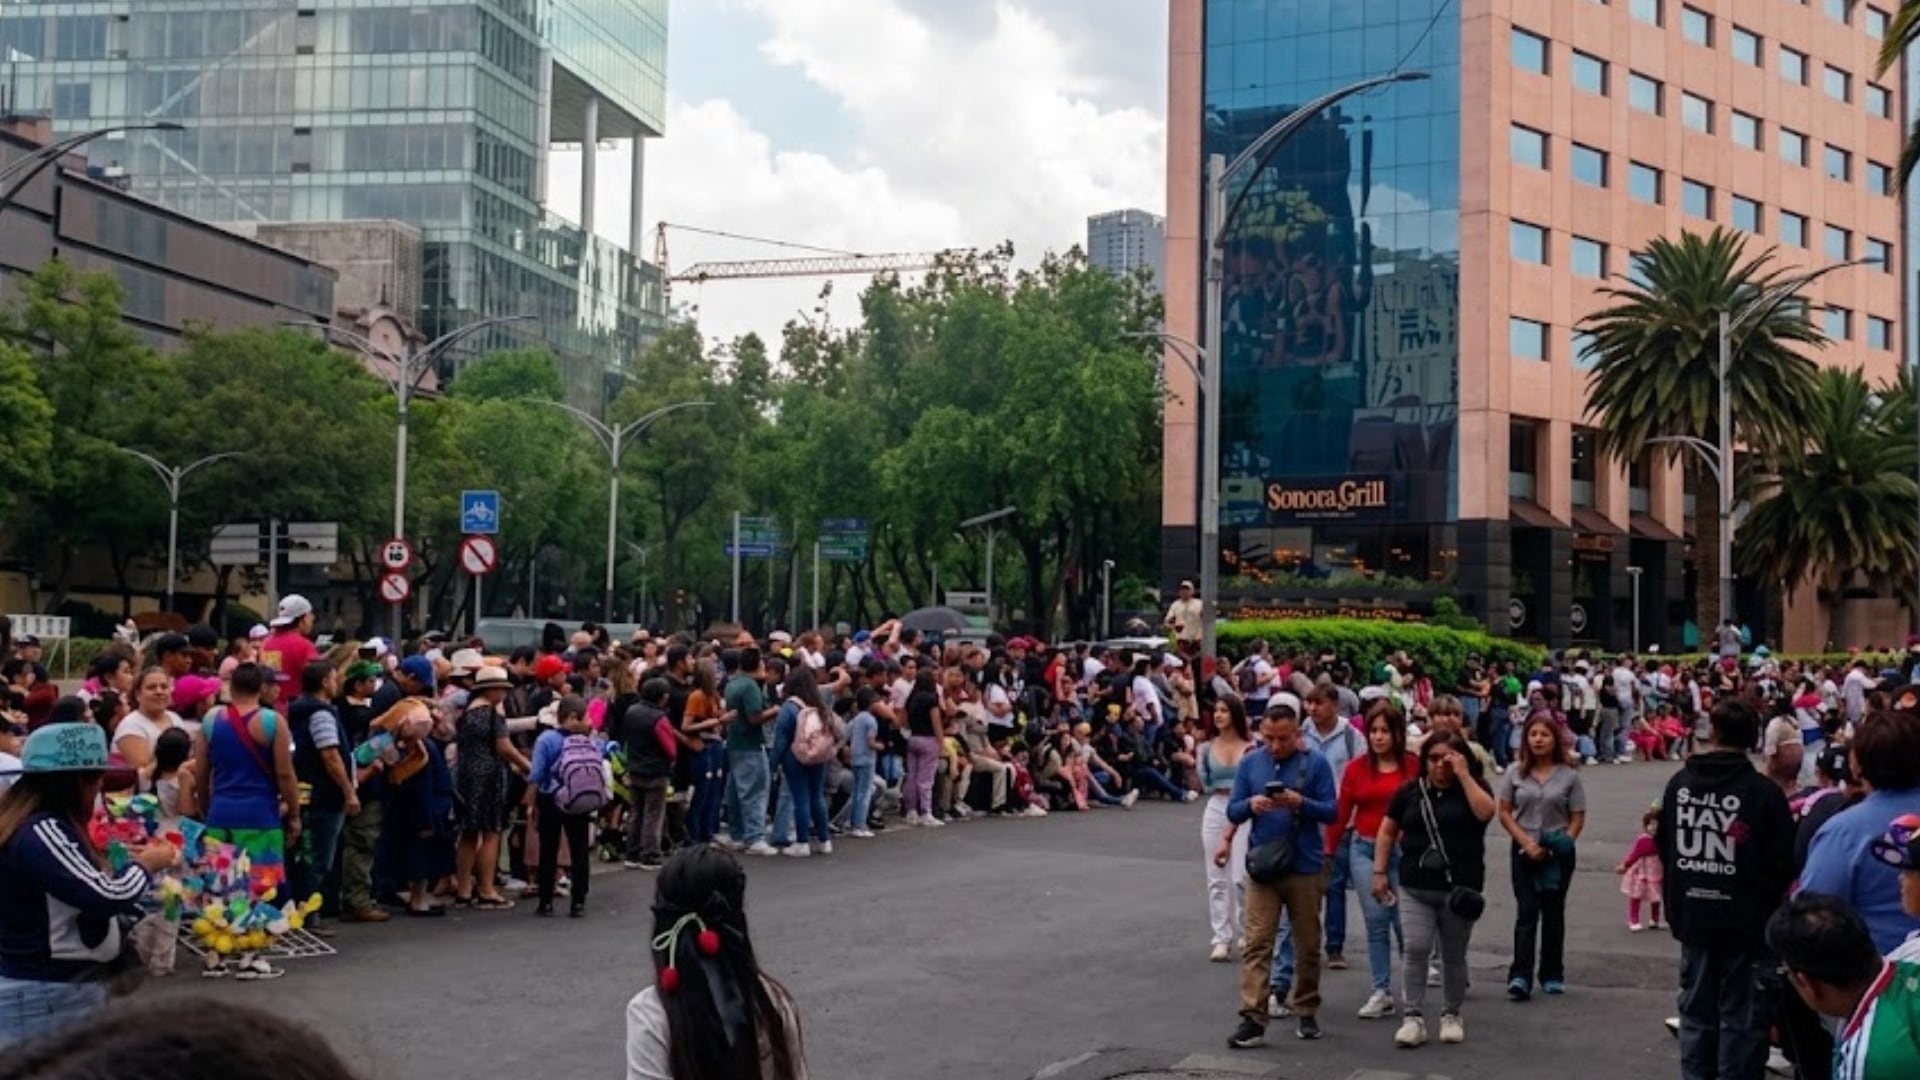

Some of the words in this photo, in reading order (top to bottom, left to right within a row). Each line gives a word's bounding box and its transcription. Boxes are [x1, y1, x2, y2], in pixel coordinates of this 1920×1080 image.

[1268, 483, 1337, 510] Sonora
[1338, 480, 1386, 510] Grill
[1677, 806, 1738, 833] HAY
[1677, 829, 1735, 861] UN
